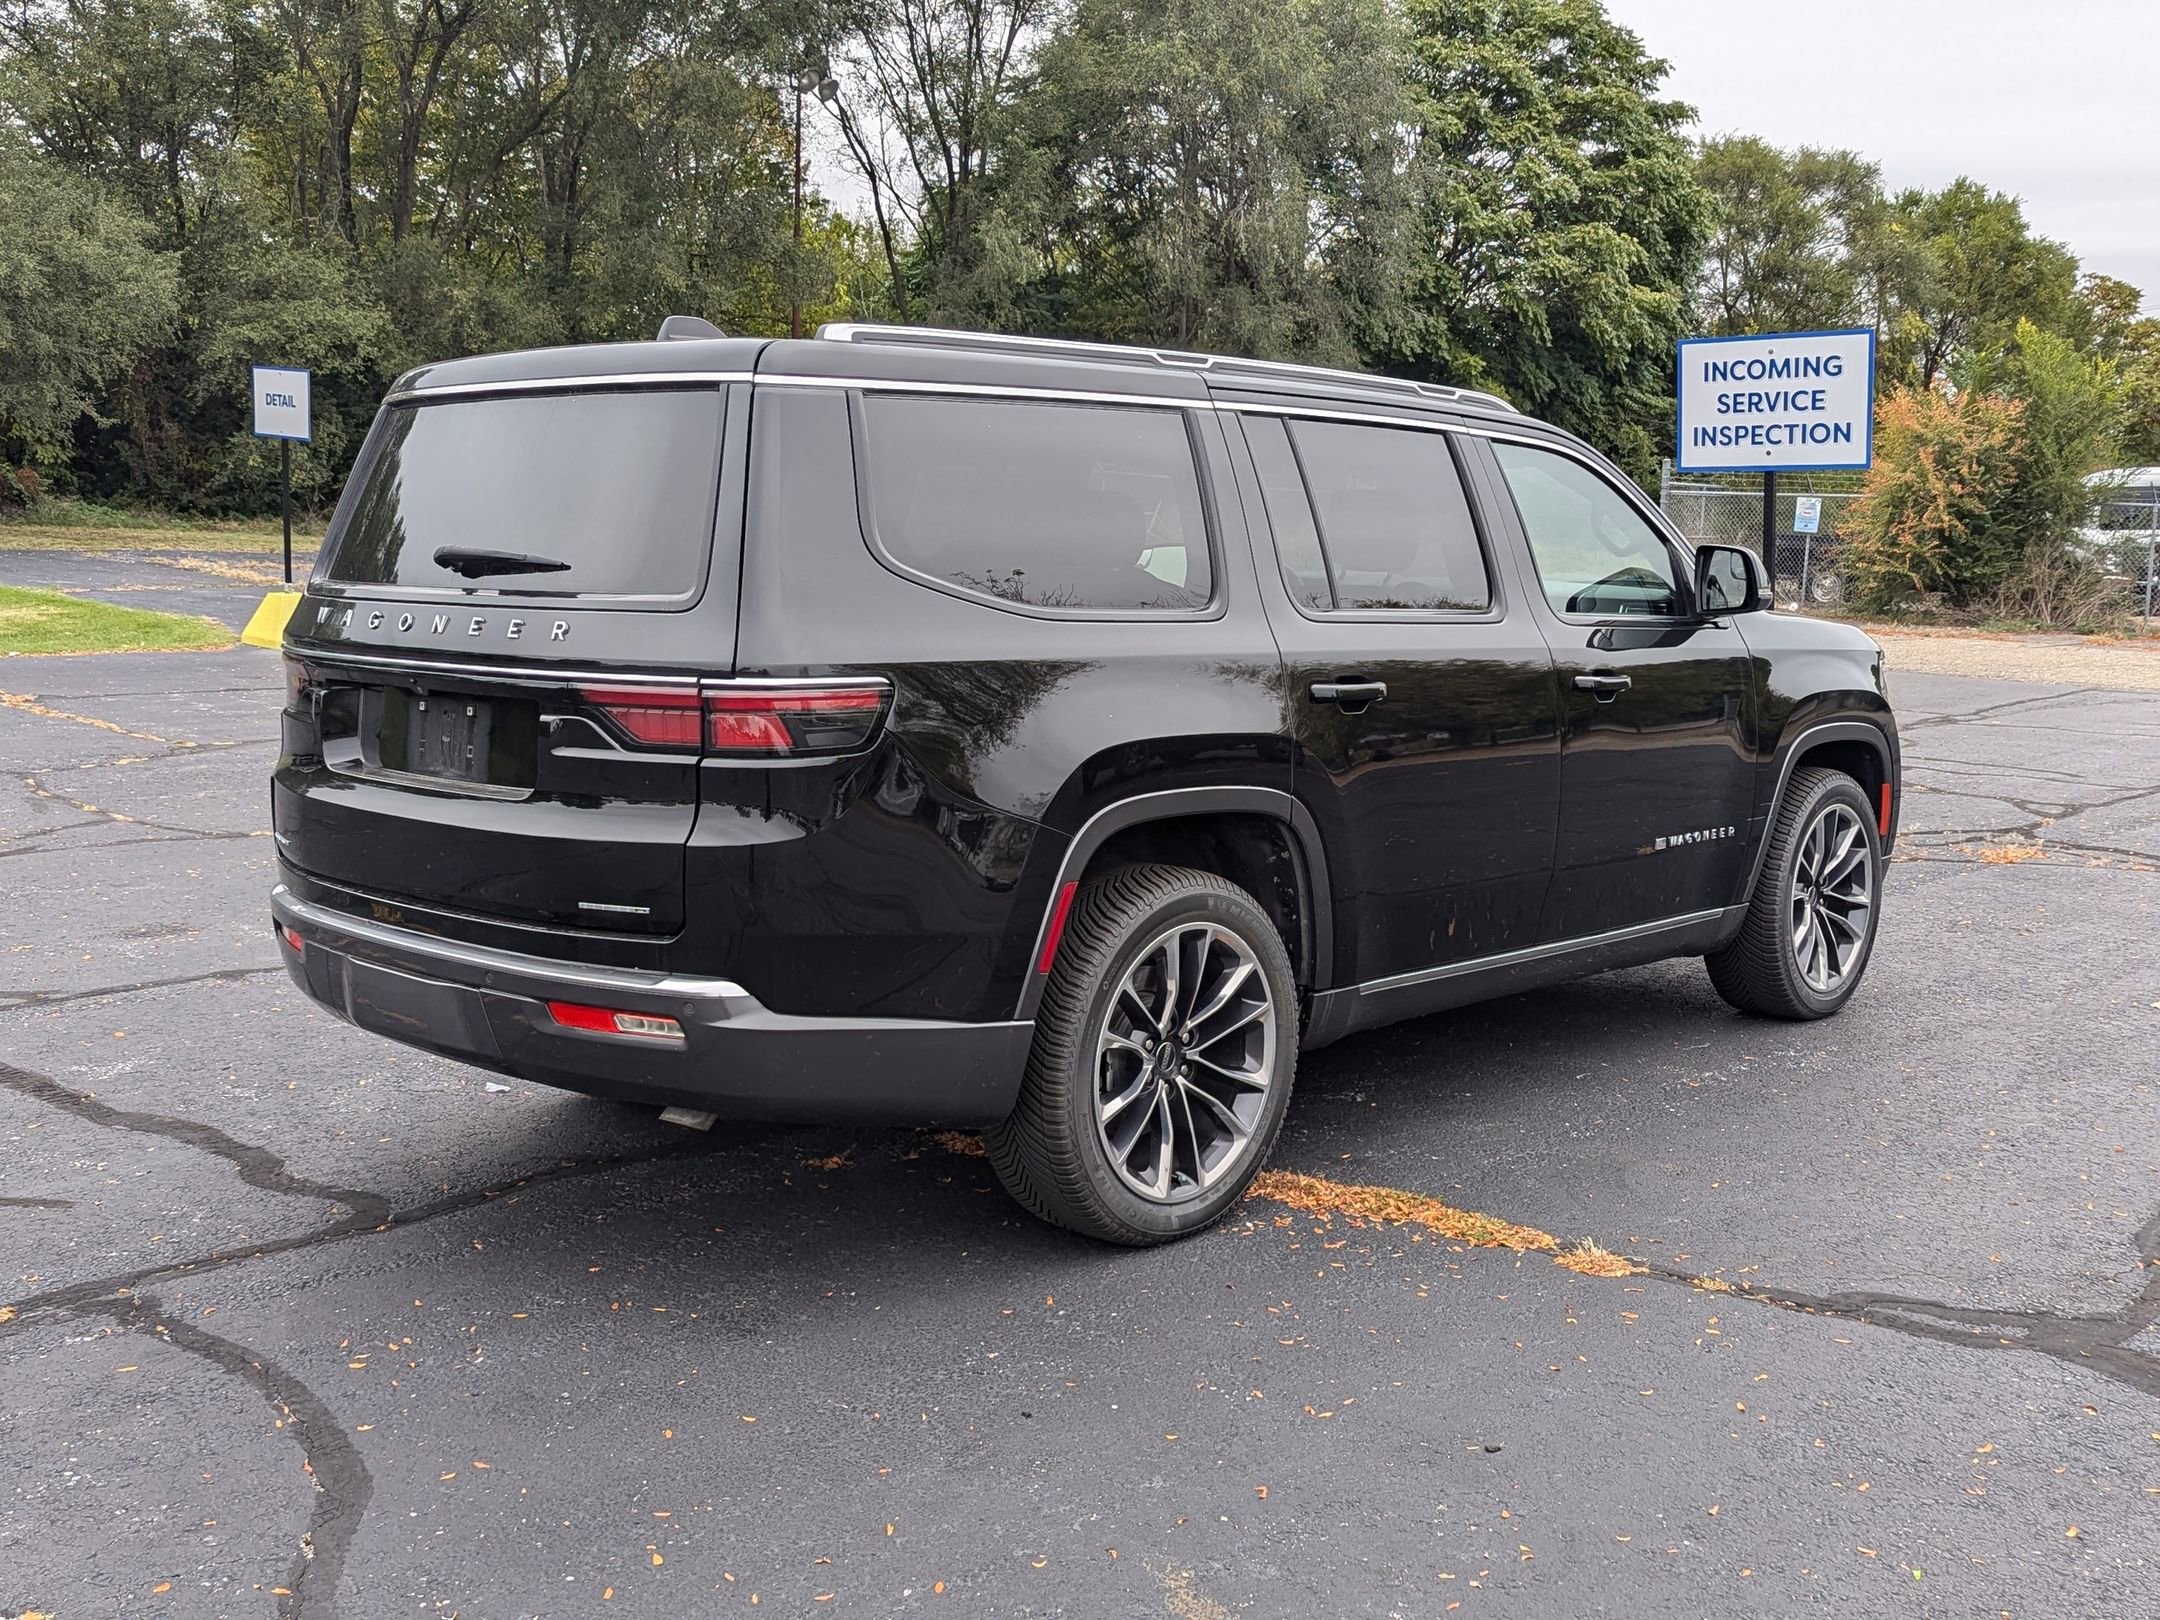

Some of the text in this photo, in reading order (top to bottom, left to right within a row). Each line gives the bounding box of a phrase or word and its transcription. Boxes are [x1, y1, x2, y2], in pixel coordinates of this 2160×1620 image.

[1703, 355, 1843, 382] INCOMING
[265, 393, 297, 408] DETAIL
[1716, 390, 1826, 414] SERVICE
[1693, 422, 1852, 447] INSPECTION
[317, 606, 571, 641] WAGONEER
[1668, 826, 1736, 847] WAGONEER
